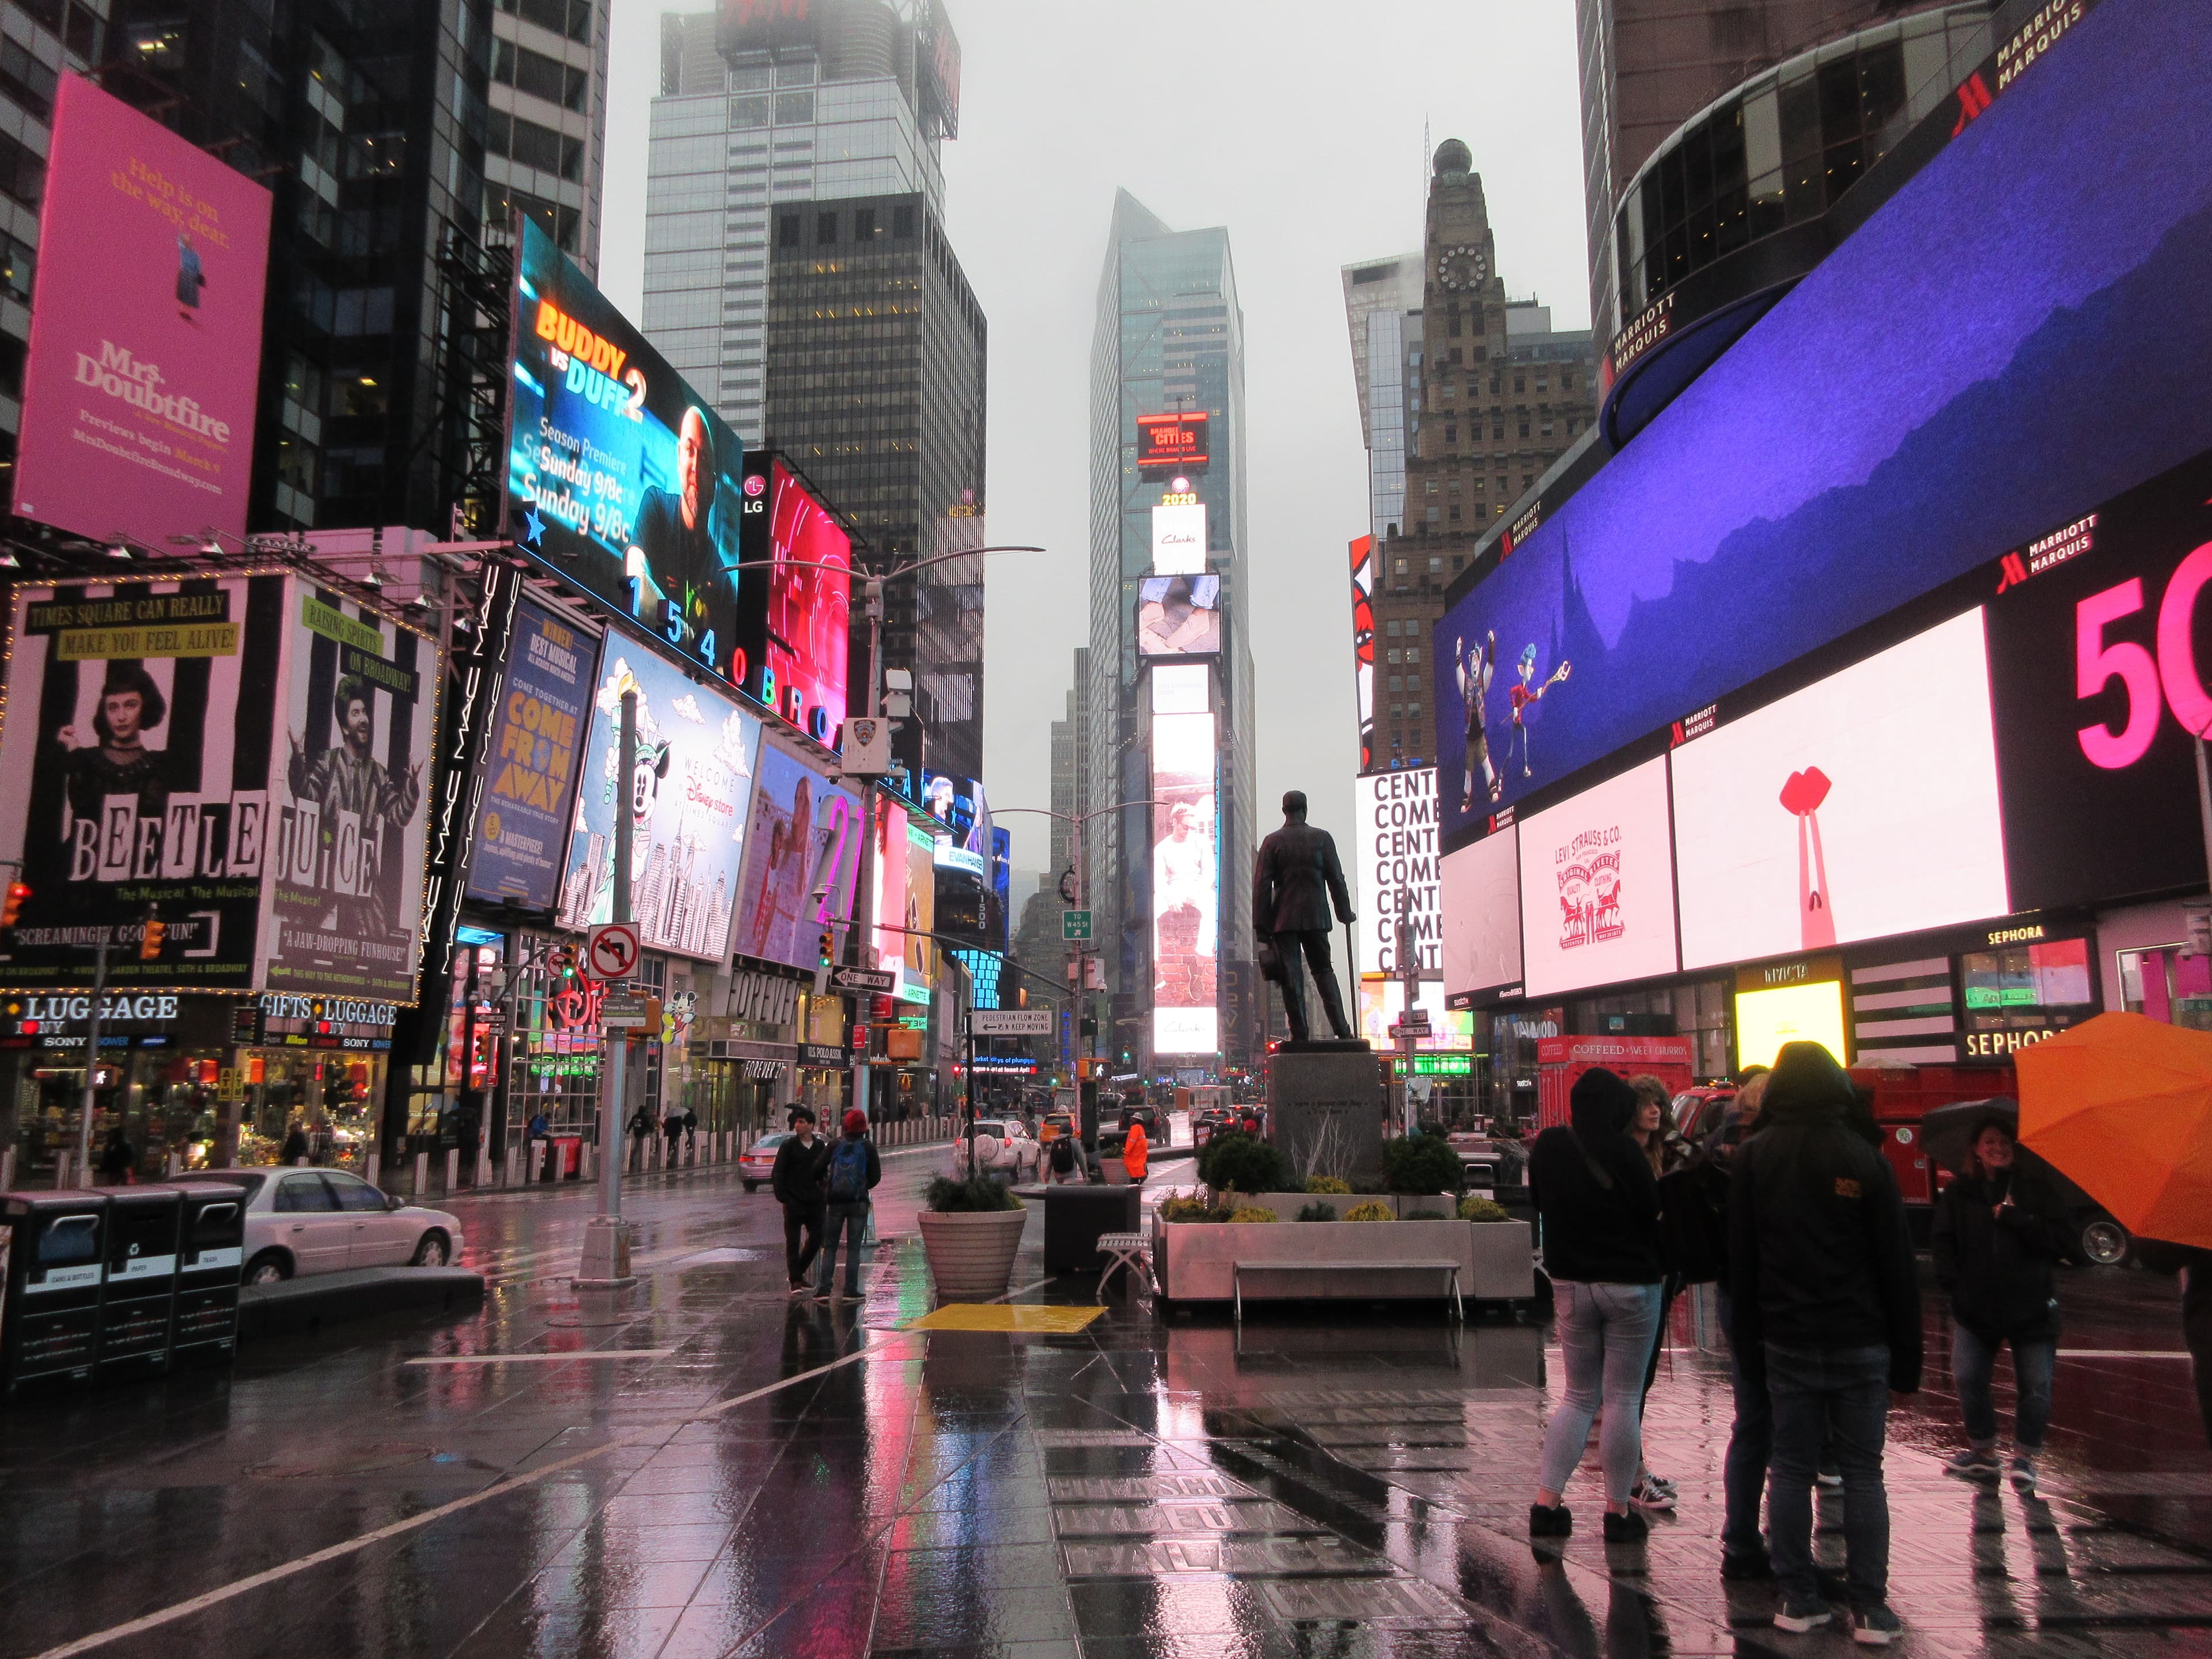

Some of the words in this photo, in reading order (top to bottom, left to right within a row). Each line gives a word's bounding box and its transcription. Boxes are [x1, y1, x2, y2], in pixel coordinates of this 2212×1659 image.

[1997, 0, 2065, 67] MARRIO
[1999, 2, 2081, 90] MARQUIS
[128, 157, 175, 199] Help
[178, 184, 194, 207] is
[196, 201, 219, 224] on
[111, 171, 143, 200] the
[188, 213, 230, 249] dear.
[1615, 292, 1675, 355] MARRIOTT
[535, 298, 627, 382] BUDDY
[1616, 319, 1666, 373] MARQUIS
[100, 339, 166, 385] Mrs.
[74, 352, 230, 443] Doubtfire
[565, 355, 630, 418] DUFF
[624, 366, 647, 425] 2
[79, 408, 135, 441] Previews
[138, 433, 172, 455] begin
[1154, 431, 1194, 446] CITIES
[539, 416, 580, 454] Season
[582, 437, 628, 476] Premiere
[539, 445, 592, 497] Sunday
[594, 469, 624, 505] 9/8c
[522, 472, 591, 536] Sunday
[594, 502, 631, 544] 9/8c
[744, 501, 763, 513] LG
[1162, 493, 1198, 506] 2020
[1513, 500, 1540, 535] MARRIOTT
[253, 536, 310, 552] LAMAR
[1161, 534, 1196, 544] Clarks
[1513, 517, 1538, 547] MARQUIS
[2028, 513, 2097, 558] MARRIOTT
[2029, 535, 2090, 574] MARQUIS
[32, 607, 74, 627] TIMES
[77, 602, 132, 626] SQUARE
[137, 598, 165, 619] CAN
[171, 594, 224, 617] REALLY
[309, 604, 344, 638] RAISING
[65, 635, 107, 654] MAKE
[113, 632, 141, 652] YOU
[146, 630, 181, 651] FEEL
[187, 628, 235, 649] ALIVE!
[629, 575, 747, 686] 1540
[530, 633, 550, 657] BEST
[548, 644, 577, 675] MUSICAL
[350, 651, 362, 672] ON
[364, 656, 411, 693] BROADWAY!
[513, 677, 533, 694] COME
[535, 687, 568, 710] TOGETHER
[569, 704, 578, 715] AT
[508, 691, 577, 749] COME
[1684, 703, 1717, 727] MARRIOTT
[1685, 718, 1714, 739] MARQUIS
[500, 723, 571, 782] FROM
[493, 761, 566, 813] AWAY
[685, 755, 735, 793] WELCOME
[490, 796, 500, 805] THE
[501, 800, 532, 816] REMARKABLE
[685, 804, 704, 819] TIMES
[708, 815, 733, 831] SQUARE
[714, 798, 734, 817] store
[1495, 805, 1515, 820] MARRIOTT
[1496, 815, 1513, 829] MARQUIS
[68, 802, 260, 881] BEETLE
[1555, 844, 1570, 864] LEVI
[1571, 830, 1601, 857] STRAUSS
[1604, 830, 1609, 846] &
[1609, 825, 1622, 844] CO.
[812, 795, 864, 931] 21
[1559, 868, 1588, 888] ORIGINAL
[1589, 857, 1619, 877] RIVETED
[117, 887, 137, 900] The
[191, 886, 213, 899] The
[274, 888, 289, 902] The
[1566, 883, 1581, 897] QUALITY
[1594, 872, 1612, 887] CLOTHING
[978, 894, 986, 930] 1500
[294, 931, 358, 955] JAW-DROPPING
[1562, 939, 1583, 949] PATENTED
[1987, 925, 2045, 945] SEPHORA
[206, 963, 248, 973] BROADWAY
[840, 972, 859, 982] ONE
[867, 975, 887, 986] WAY
[1764, 963, 1809, 983] INVICTA
[25, 996, 179, 1020] LUGGAGE
[907, 990, 927, 1001] ARNETTE
[1453, 997, 1468, 1006] swatch
[260, 994, 312, 1018] GIFTS
[324, 999, 398, 1026] LUGGAGE
[1033, 1013, 1048, 1021] ZONE
[1012, 1023, 1025, 1031] KEEP
[44, 1037, 87, 1047] SONY
[343, 1038, 370, 1048] SONY
[816, 1047, 830, 1058] POLO
[1541, 1043, 1563, 1056] COFFEED
[1573, 1044, 1624, 1055] COFFEED
[1630, 1046, 1653, 1055] SWEET
[1655, 1046, 1687, 1055] CHURROS
[1966, 1029, 2067, 1056] SEPHO
[743, 1059, 774, 1079] FOREVER
